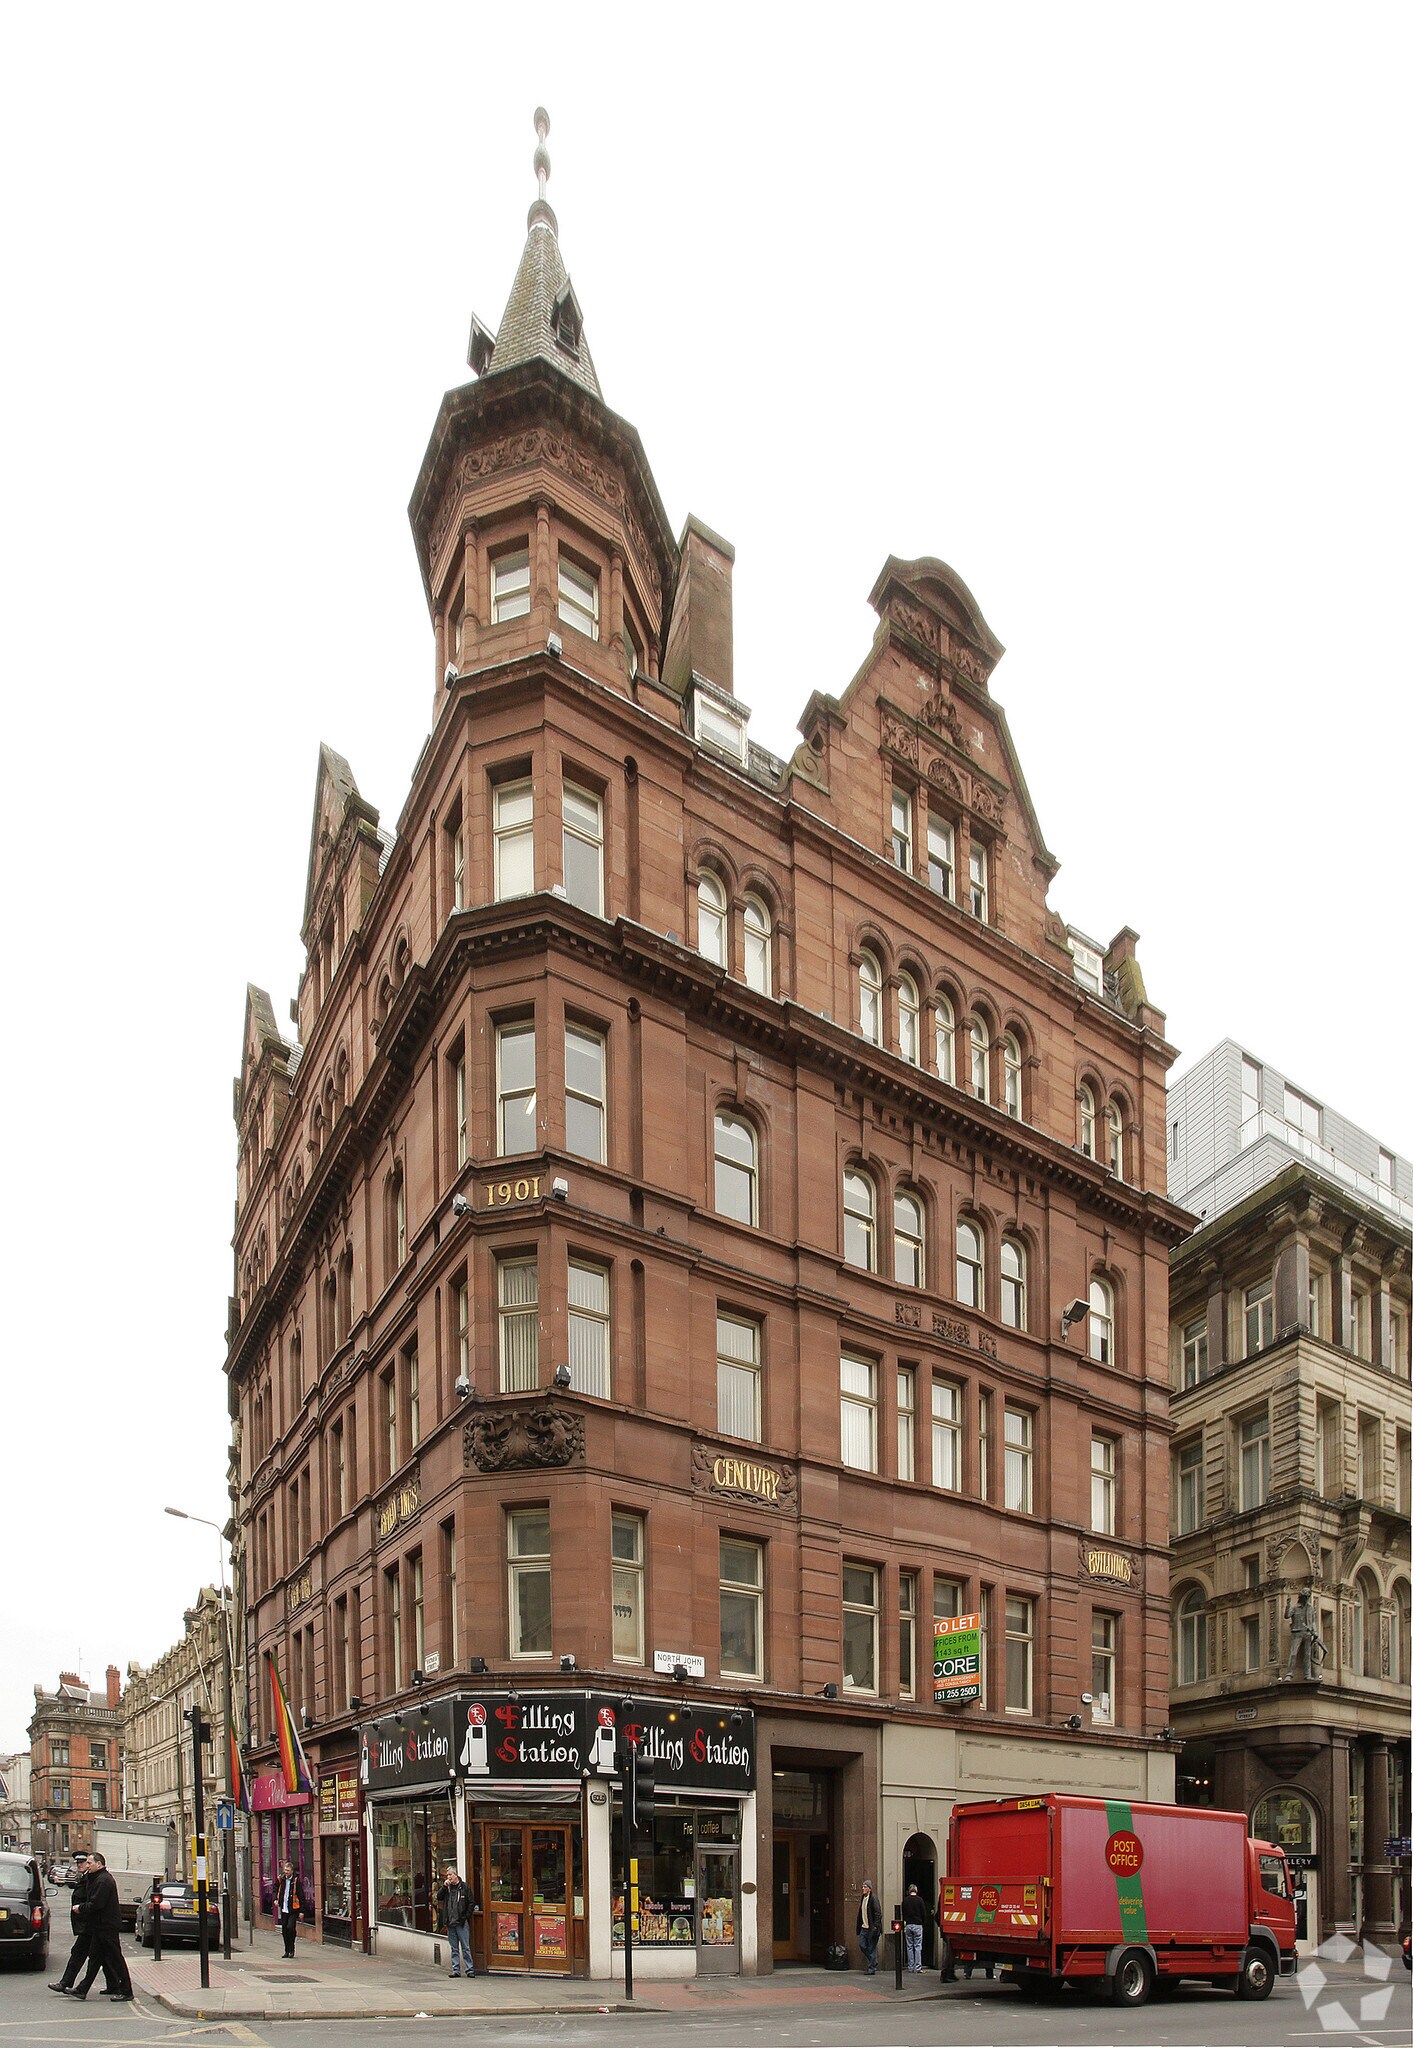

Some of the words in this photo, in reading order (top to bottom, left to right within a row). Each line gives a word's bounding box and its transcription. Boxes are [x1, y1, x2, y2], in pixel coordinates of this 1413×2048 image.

[487, 1176, 540, 1206] 1901
[933, 1621, 949, 1634] TO
[951, 1616, 976, 1631] LET
[958, 1633, 977, 1643] FROM
[657, 1653, 681, 1663] NORTH
[684, 1656, 702, 1666] JOHN
[933, 1656, 976, 1677] CORE
[946, 1689, 959, 1698] 255
[960, 1686, 977, 1697] 2500
[494, 1704, 575, 1737] Filling
[370, 1740, 404, 1775] Filling
[405, 1728, 450, 1766] Station
[495, 1736, 581, 1771] Station
[621, 1723, 684, 1771] Filling
[689, 1727, 751, 1777] Station
[683, 1821, 700, 1836] Freh
[700, 1820, 720, 1835] coffee
[1113, 1840, 1136, 1853] POST
[1109, 1853, 1138, 1867] OFFICE
[982, 1891, 996, 1899] POST
[980, 1898, 998, 1907] OFFICE
[1118, 1896, 1143, 1909] delivering
[1123, 1906, 1138, 1915] value
